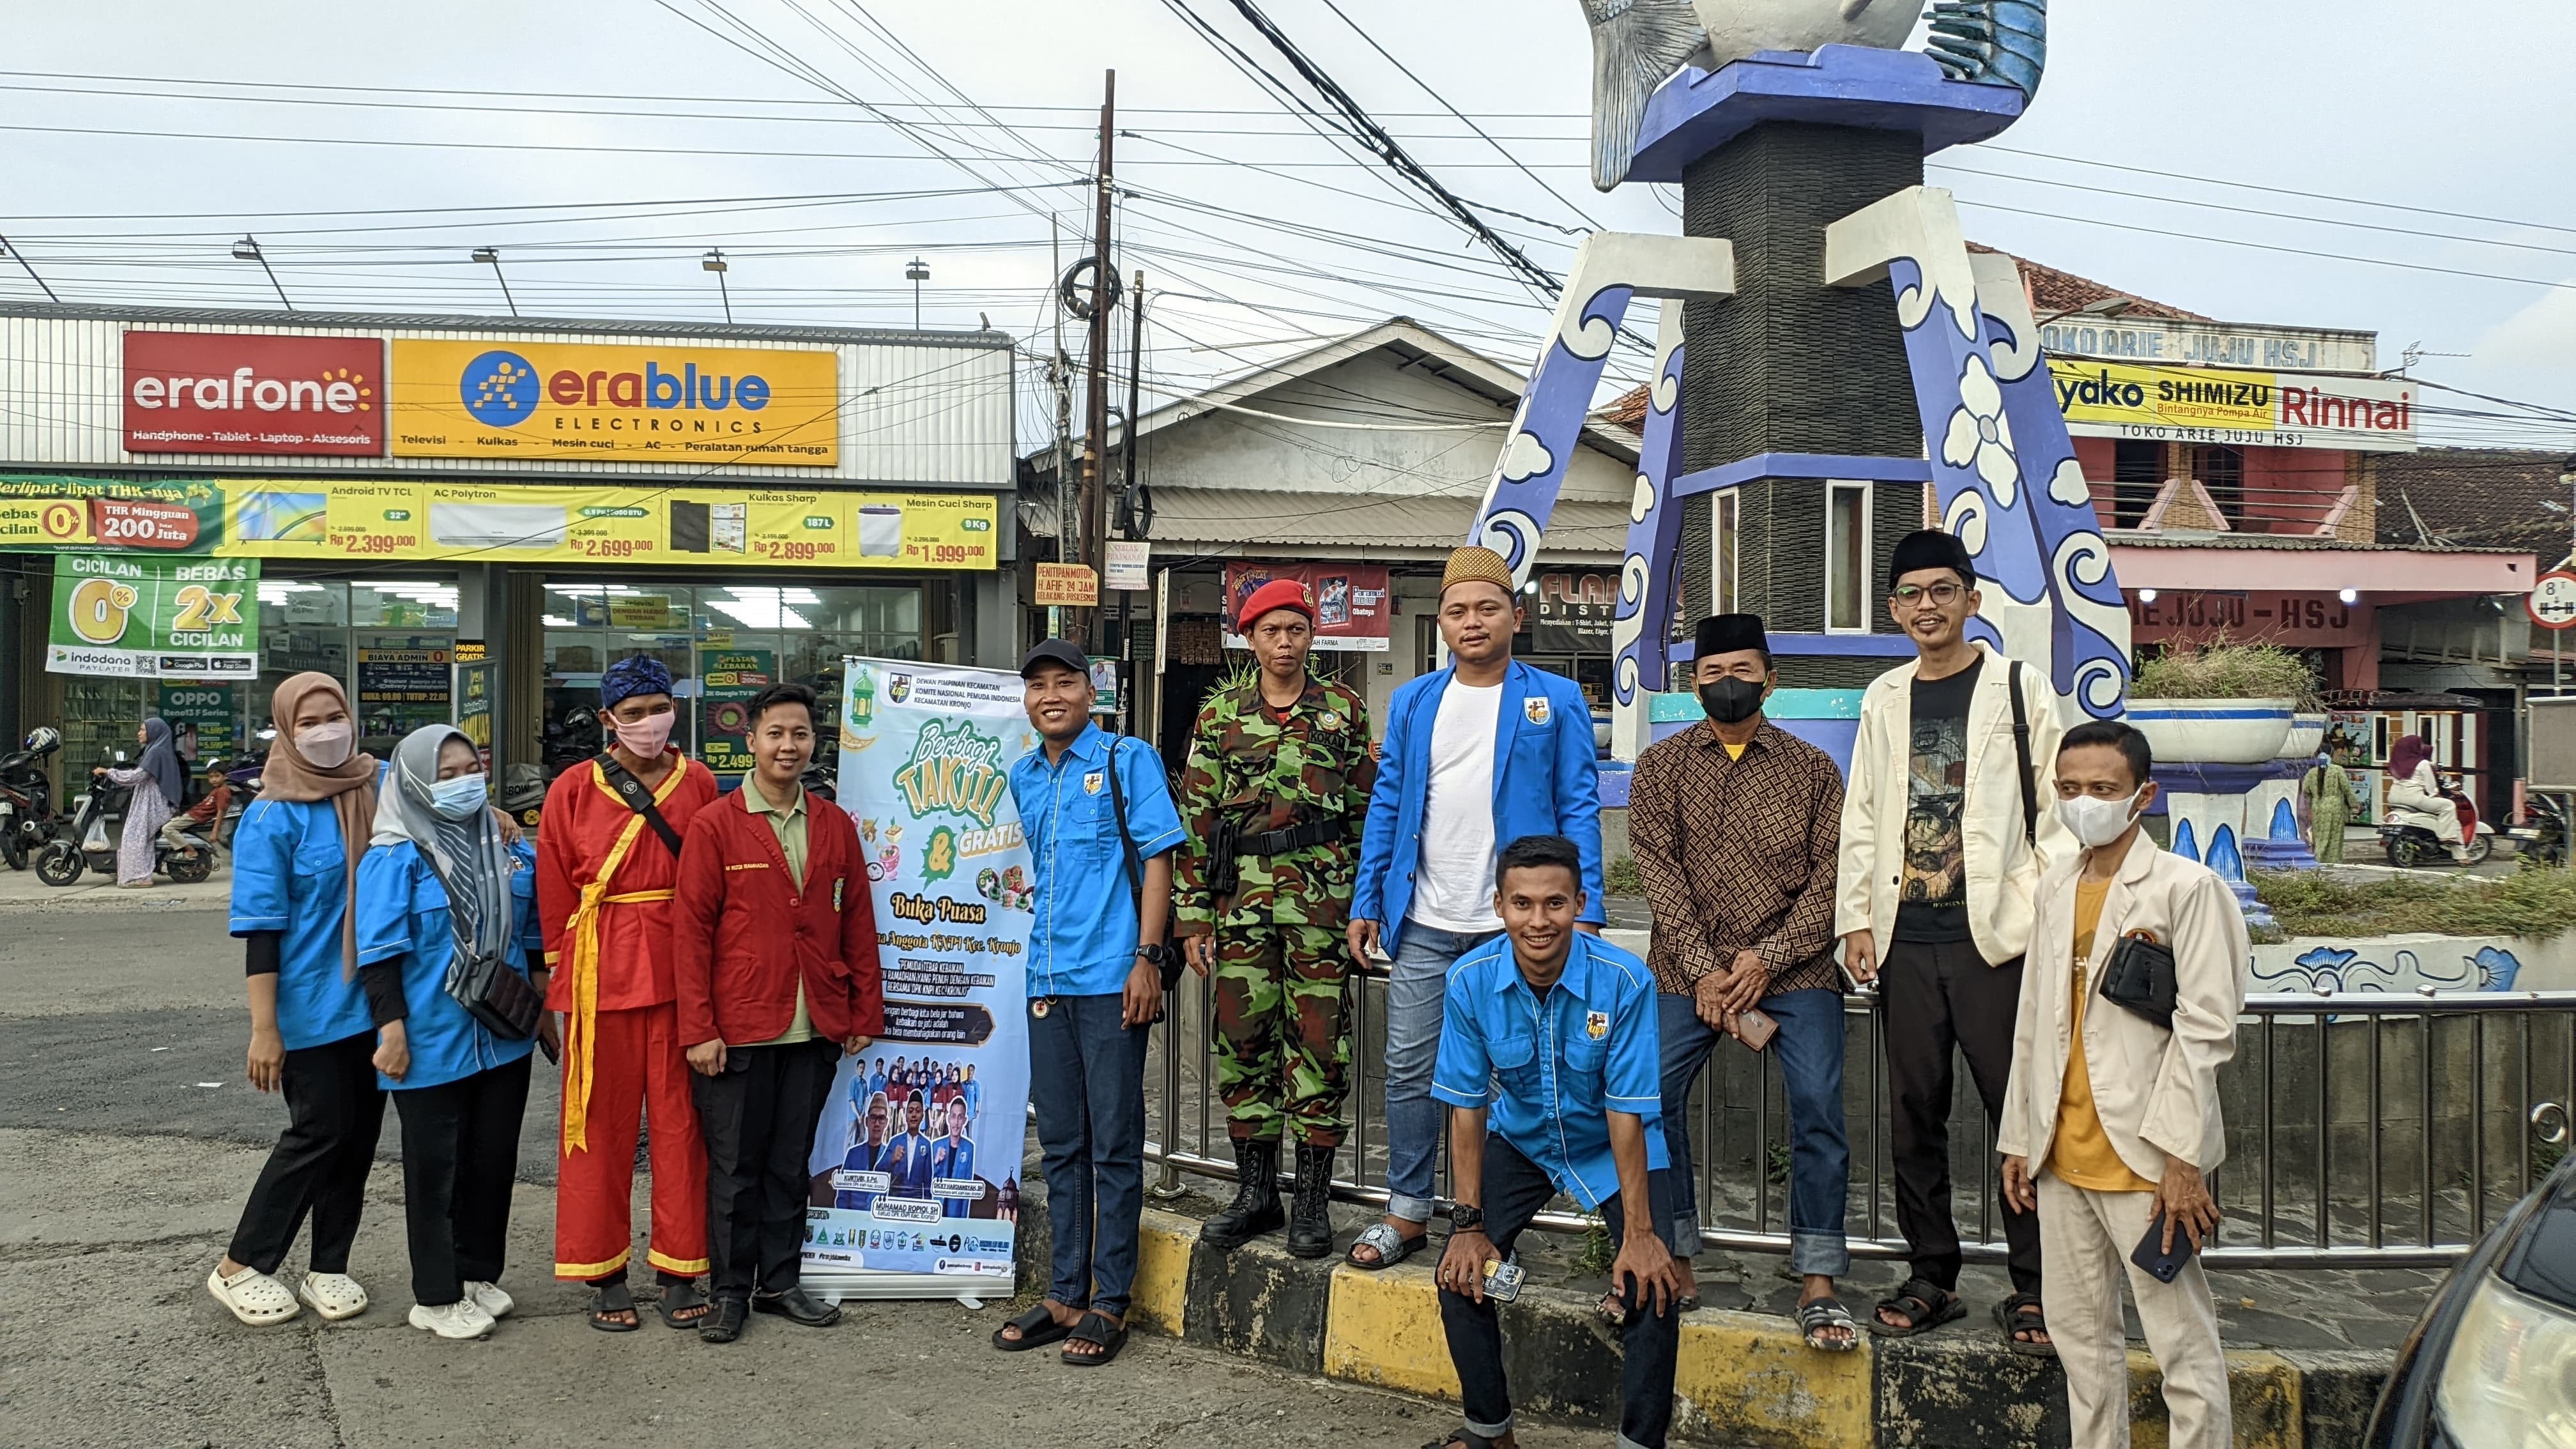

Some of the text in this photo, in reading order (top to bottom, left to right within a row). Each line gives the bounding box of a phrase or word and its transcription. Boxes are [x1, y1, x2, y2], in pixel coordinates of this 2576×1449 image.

[2037, 325, 2316, 368] OKO ARIE JUJU HSJ
[133, 367, 357, 413] erafone
[548, 362, 770, 411] erablue
[2158, 380, 2267, 406] SHIMIZU
[2157, 404, 2267, 418] Bintangnya Pompa Air
[2282, 386, 2409, 431] Rinnai
[556, 417, 761, 434] ELECTRONICS
[133, 431, 371, 444] Handphone Tablet Laptop Aksesoris
[2120, 424, 2303, 445] TOKO ARIE JUJU HSJ
[401, 435, 828, 456] Televisi Kulkas Mesin cuci AC Peralatan rumah tangga
[332, 487, 374, 496] Android
[452, 489, 496, 500] Polytron
[749, 494, 784, 502] Kulkas
[786, 495, 816, 505] Sharp
[907, 499, 992, 510] Mesin Cuci Sharp
[104, 506, 189, 519] THR Mingguan
[48, 507, 79, 535] 0%
[808, 518, 824, 528] 187
[965, 521, 986, 530] 9 Kg
[104, 518, 155, 538] 200
[157, 528, 187, 541] Juta
[330, 535, 415, 553] Rp 2.399.000
[571, 539, 652, 556] Rp 2.699.000
[754, 542, 835, 560] Rp 2.899.000
[907, 545, 985, 563] Rp 1.999.000
[73, 559, 142, 577] CICILAN
[176, 566, 247, 581] BEBAS
[1038, 581, 1062, 591] H.AFIF
[1067, 581, 1075, 591] 24
[1078, 582, 1094, 592] JAM
[1353, 586, 1384, 597] Paramex
[2546, 582, 2555, 595] 8
[1037, 592, 1064, 601] BELAKANG
[1353, 608, 1374, 617] Obatnya
[2124, 595, 2349, 628] IE JUJU HSJ
[170, 633, 243, 647] CICILAN
[72, 652, 130, 665] indodana
[456, 653, 484, 661] GRATIS
[80, 664, 130, 673] PAYLATER
[937, 679, 965, 687] PIMPINAN
[967, 681, 1000, 691] KECAMATAN
[171, 692, 221, 705] OPPO
[915, 687, 1021, 703] KOMITE NASIONAL PEMUDA INDONESIA
[914, 697, 971, 709] KECAMATAN KRONJO
[915, 723, 998, 772] Berbagi
[707, 755, 717, 763] Rp
[897, 756, 1004, 825] TAKJIL
[960, 822, 1023, 856] GRATIS
[929, 832, 952, 872] &
[891, 894, 985, 923] Buka Puasa
[888, 931, 928, 950] Anggota
[931, 933, 962, 951] KNPI
[964, 937, 985, 953] Kec.
[988, 937, 1021, 956] Kronjo
[923, 962, 963, 973] TEBAR KEBAIKAN
[888, 970, 995, 986] RAMADHAN YANG PENUH DENGAN KEBAIKAN
[887, 981, 910, 992] BERSAMA
[901, 1007, 919, 1017] berbagi
[896, 1017, 917, 1027] kebaikan
[942, 1030, 956, 1039] orang
[876, 1202, 907, 1211] MUHAMAD
